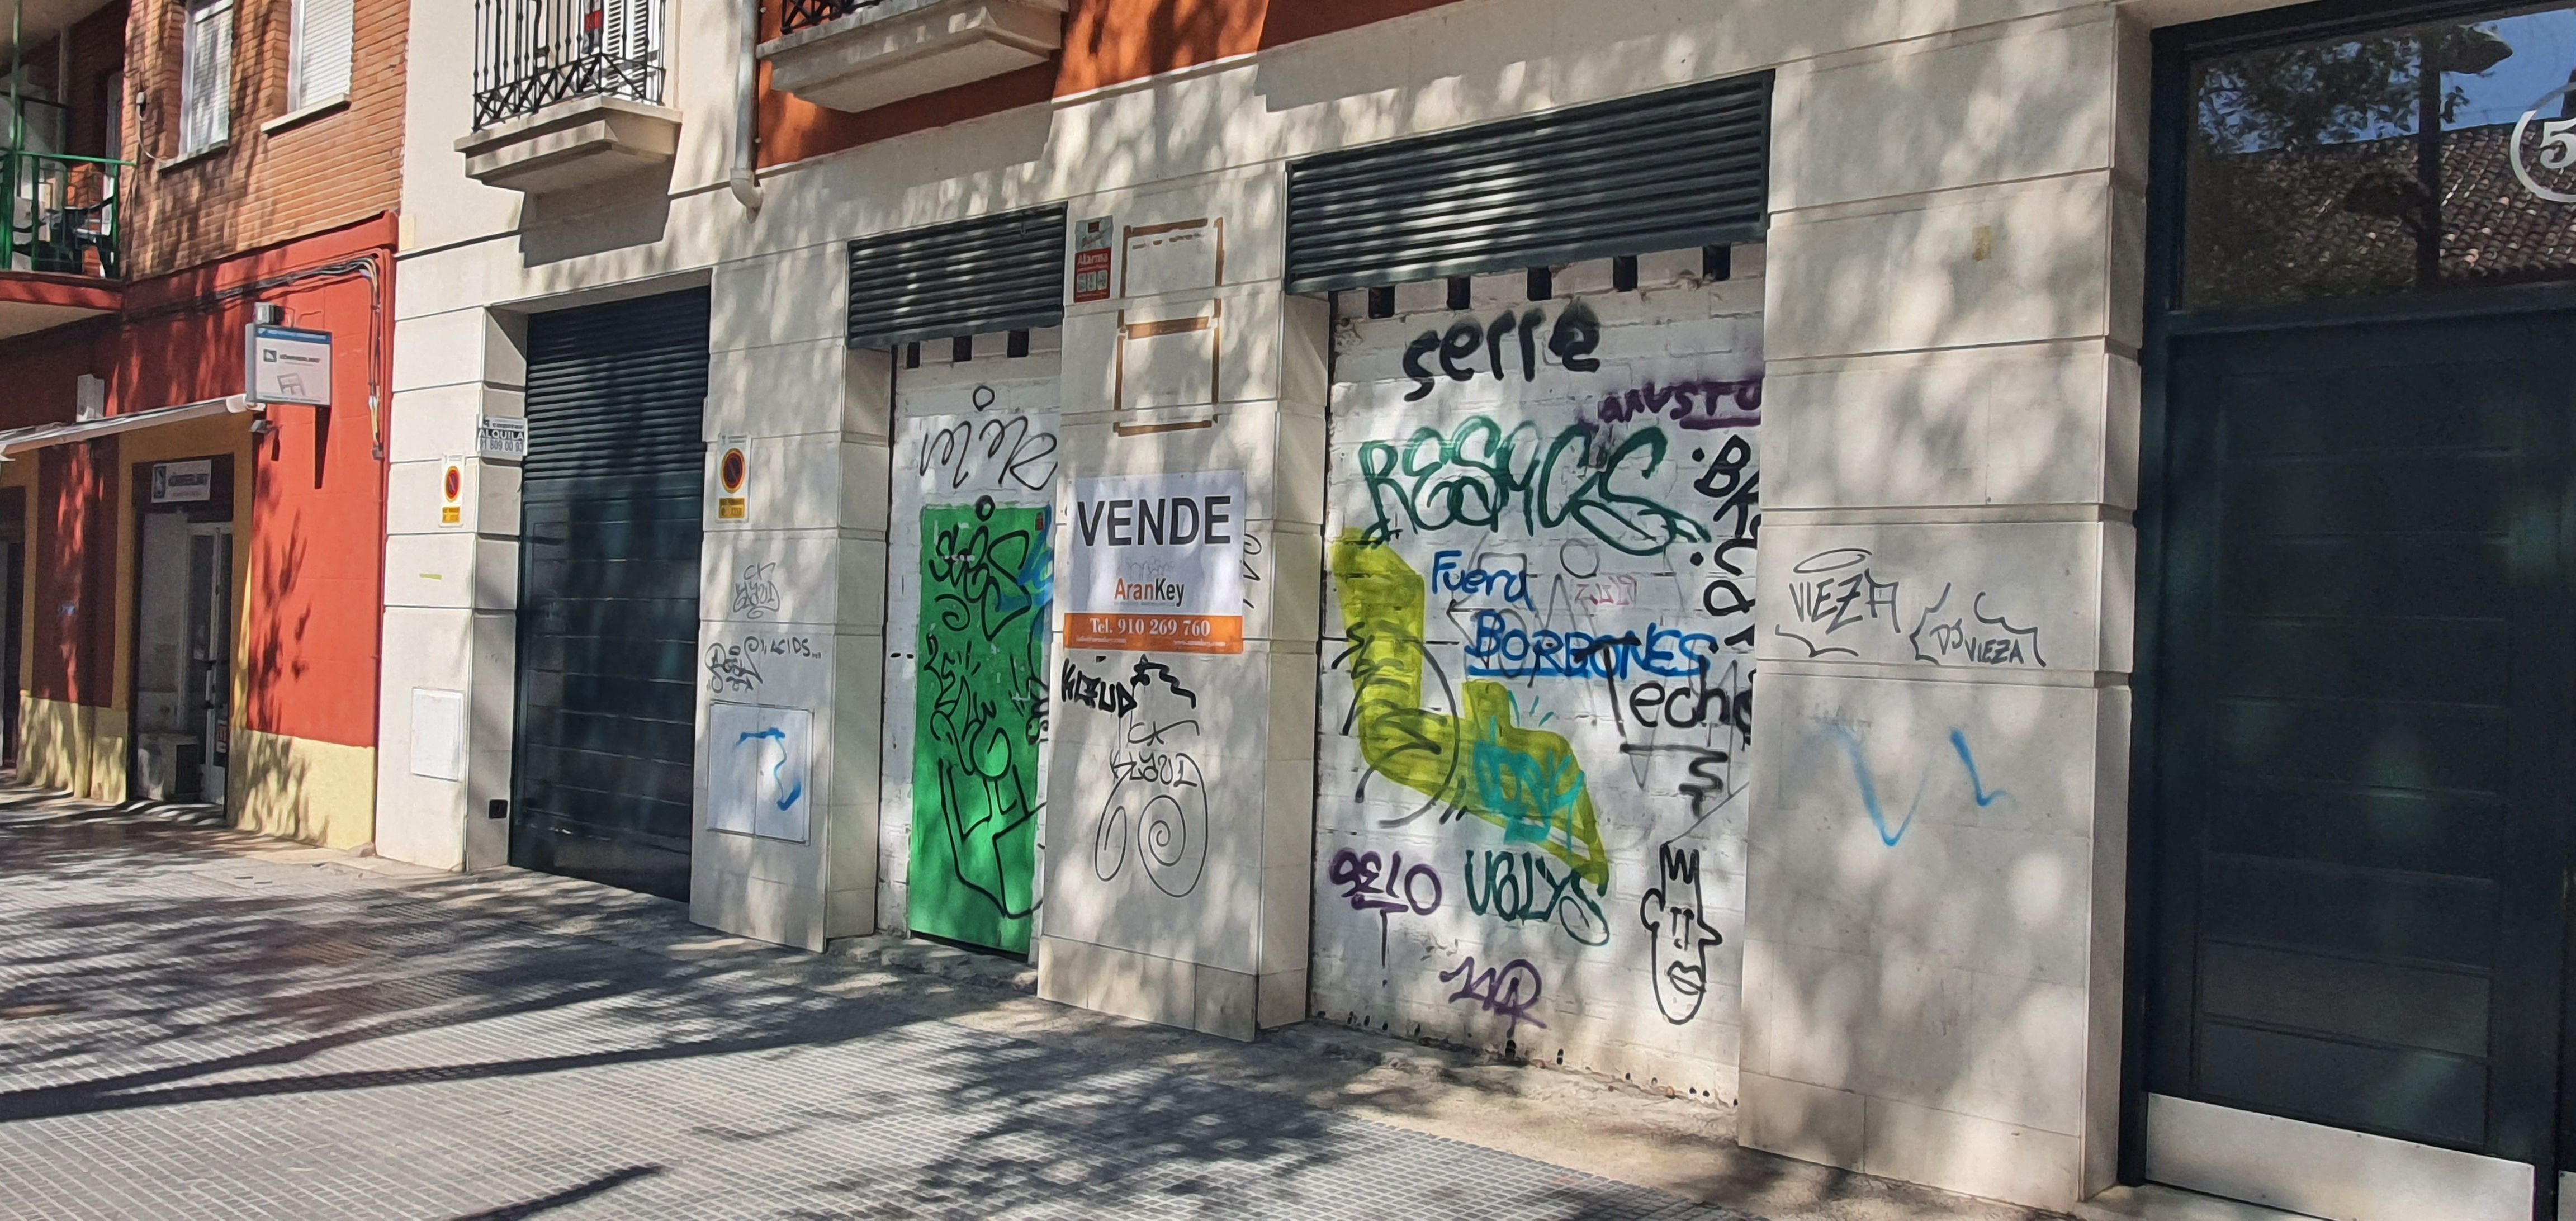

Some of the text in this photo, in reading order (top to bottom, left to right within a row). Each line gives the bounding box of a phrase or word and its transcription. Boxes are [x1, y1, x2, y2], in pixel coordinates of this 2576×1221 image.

[1077, 253, 1109, 265] Alarma
[478, 429, 524, 441] ALQUILA
[1077, 496, 1231, 546] VENDE
[1114, 578, 1185, 607] AranKey
[1432, 550, 1536, 611] Fuera
[1789, 568, 1901, 634] VIEZA
[1091, 618, 1211, 636] Tel. 910 269 760
[1464, 610, 1718, 679] BORBONES
[1964, 636, 2024, 664] VIEZA
